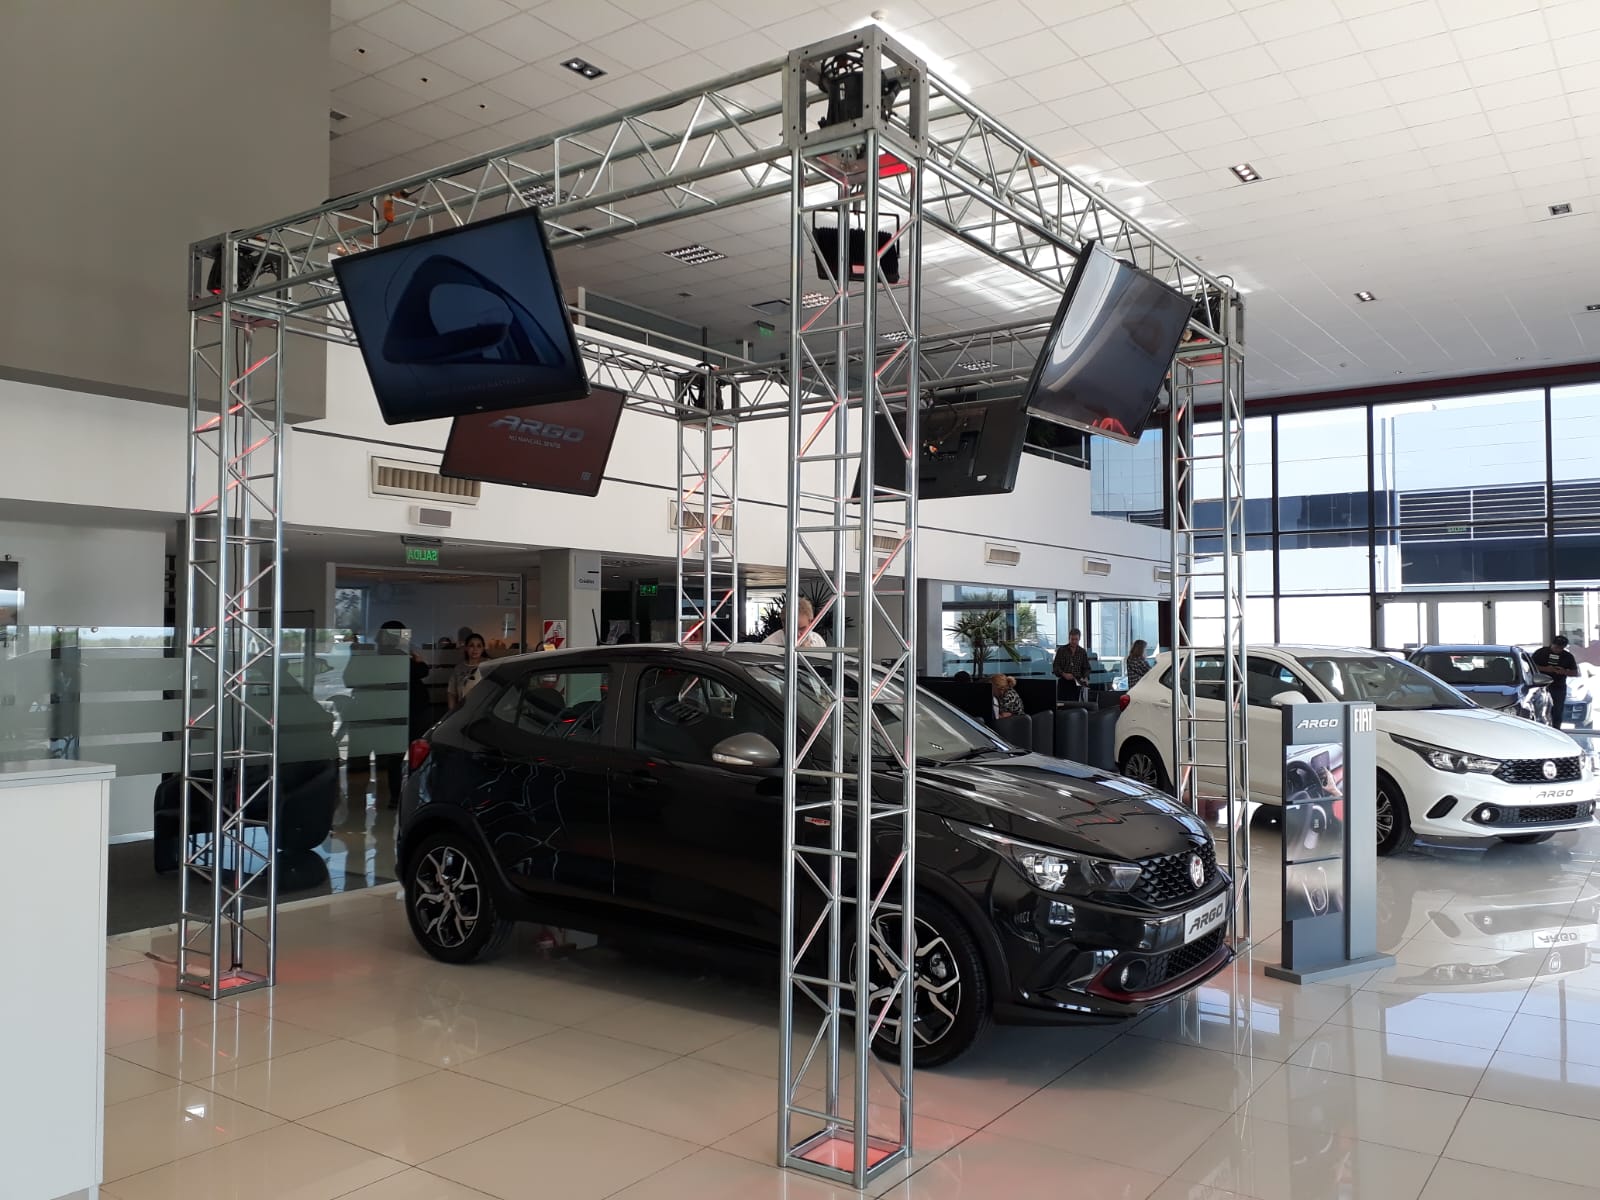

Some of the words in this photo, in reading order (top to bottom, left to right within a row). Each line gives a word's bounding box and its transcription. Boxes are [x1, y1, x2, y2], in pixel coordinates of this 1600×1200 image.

[488, 415, 585, 442] ARGO
[1296, 718, 1339, 729] ARGO
[1354, 708, 1373, 732] FIAT
[1536, 789, 1574, 799] ARGO
[1188, 902, 1224, 935] ARGO
